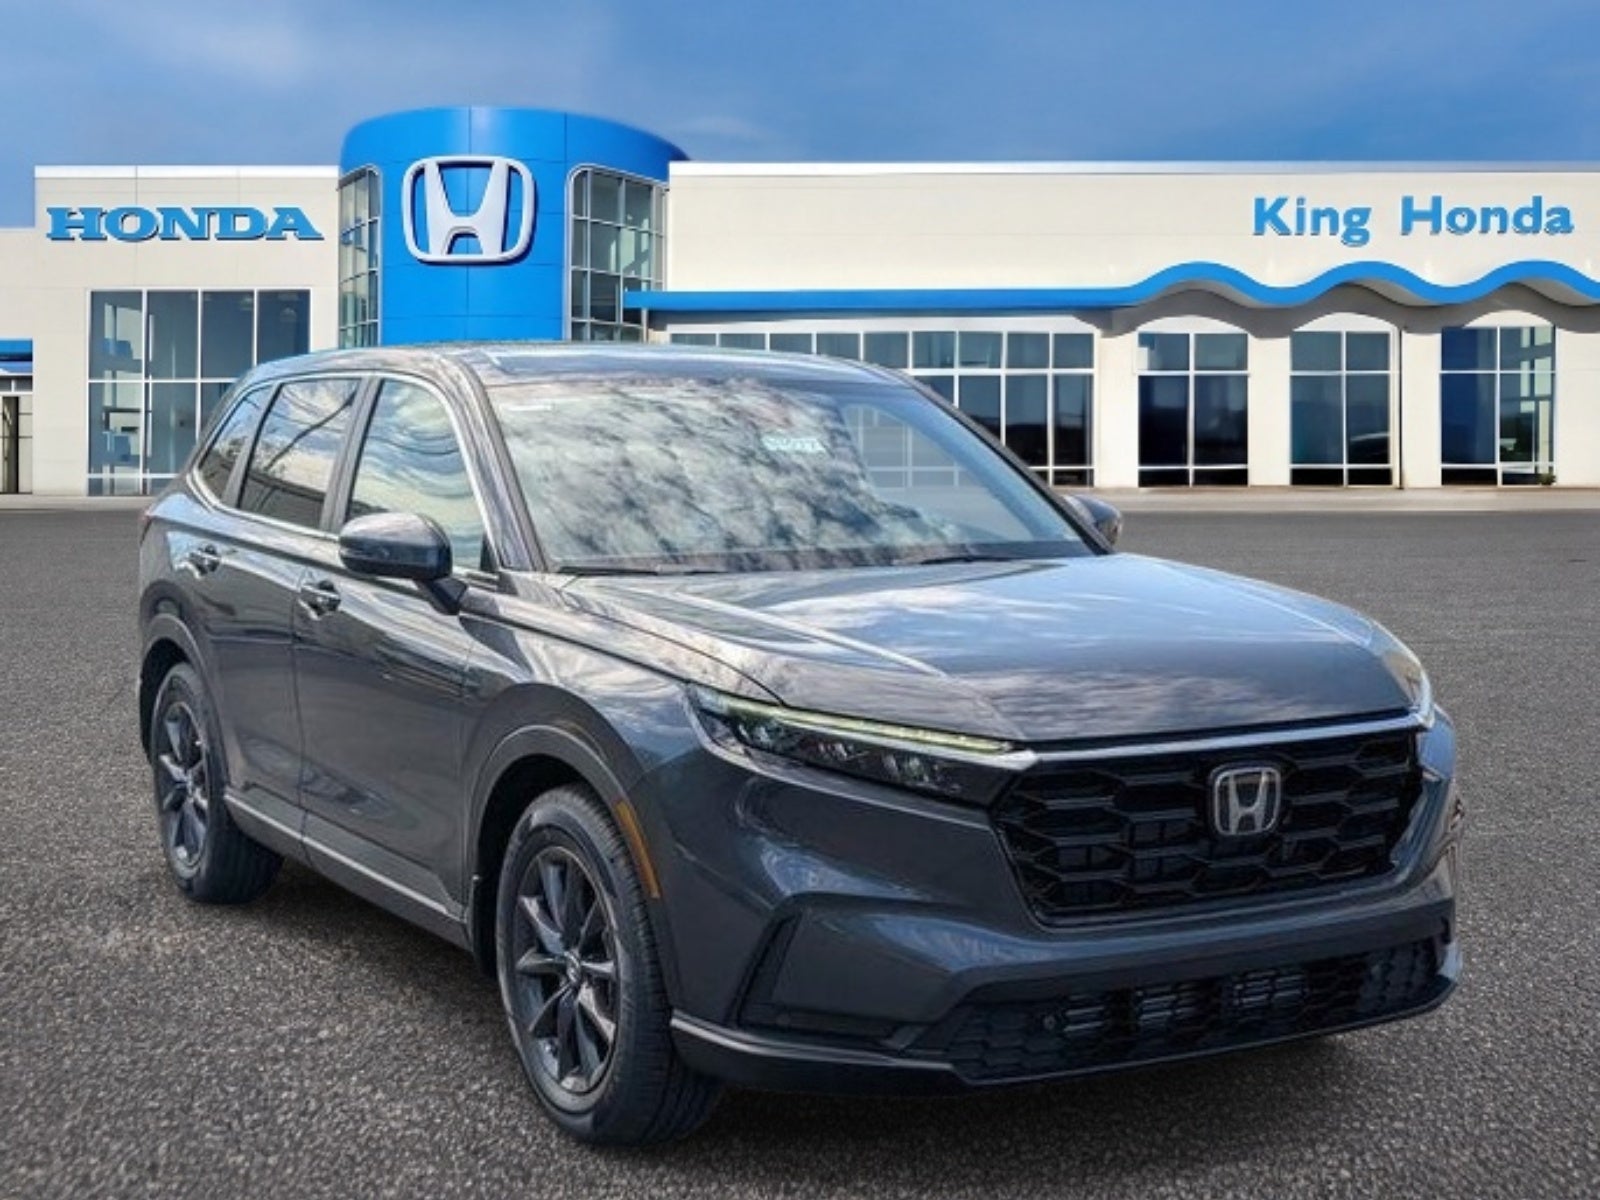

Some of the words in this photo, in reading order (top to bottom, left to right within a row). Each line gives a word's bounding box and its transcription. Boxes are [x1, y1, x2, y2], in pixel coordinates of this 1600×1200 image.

[46, 206, 325, 243] HONDA
[1253, 196, 1372, 247] King
[1400, 195, 1575, 236] Honda
